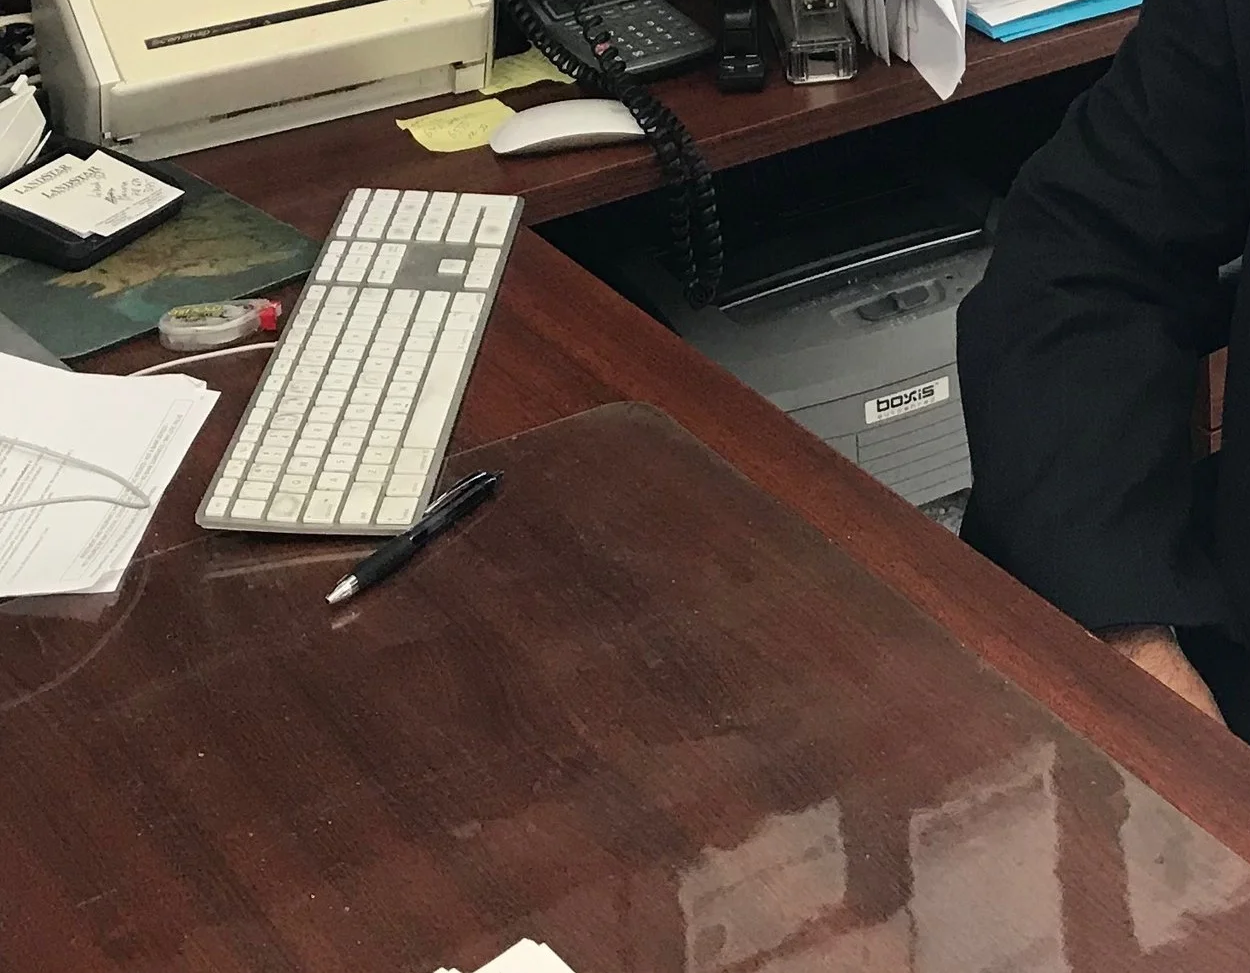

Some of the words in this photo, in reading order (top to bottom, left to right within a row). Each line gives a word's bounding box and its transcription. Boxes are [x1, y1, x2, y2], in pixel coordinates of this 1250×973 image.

[14, 163, 73, 195] LANDSTAR
[41, 166, 101, 199] LANDSTAR
[877, 385, 934, 412] boxis
